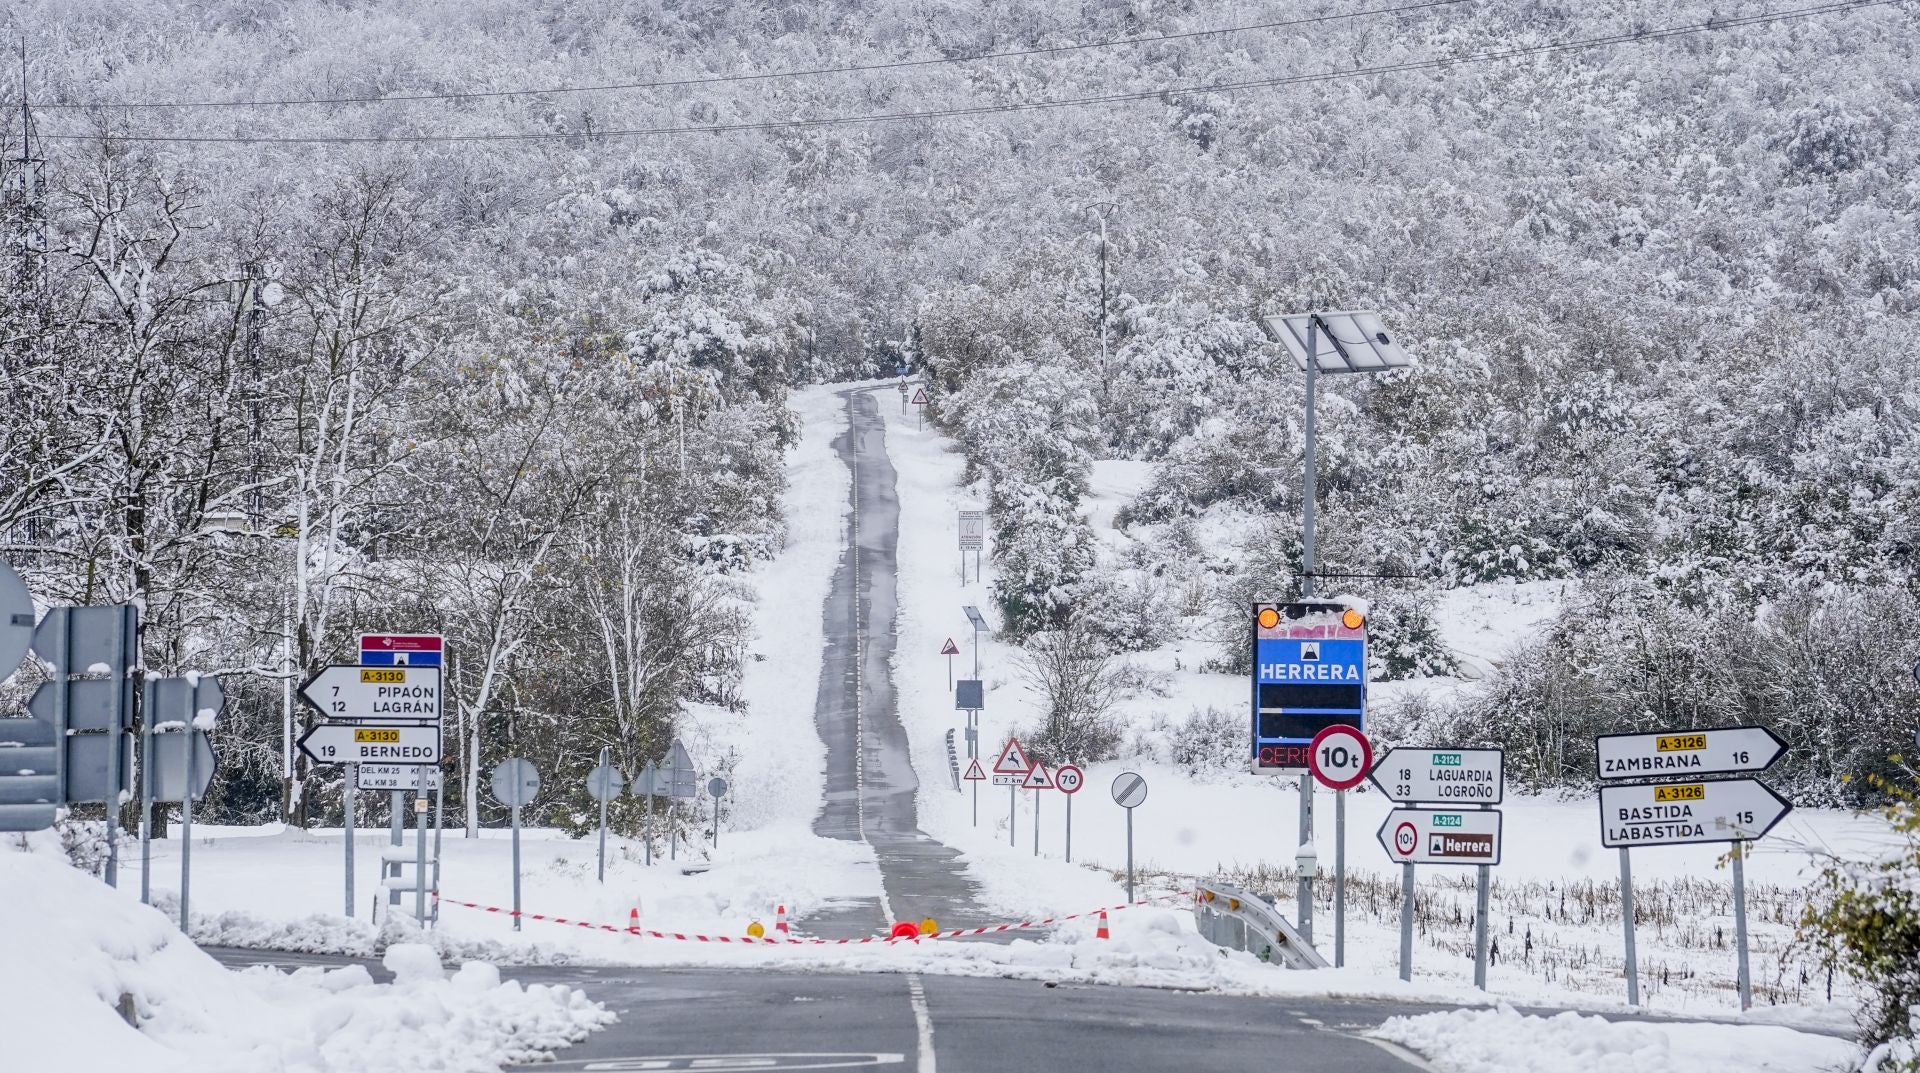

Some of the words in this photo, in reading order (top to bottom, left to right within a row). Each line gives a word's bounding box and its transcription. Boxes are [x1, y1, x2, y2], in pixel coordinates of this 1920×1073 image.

[363, 672, 404, 681] A-3130
[1260, 663, 1360, 680] HERRERA
[332, 686, 340, 697] 7
[378, 685, 434, 698] PIPAÓN
[332, 701, 346, 712] 12
[373, 699, 434, 713] LAGRÁN
[357, 731, 398, 741] A-3130
[1659, 736, 1704, 750] A-3126
[321, 745, 336, 757] 19
[360, 746, 433, 758] BERNEDO
[1433, 755, 1460, 765] A-2124
[1605, 754, 1701, 772] ZAMBRANA
[1732, 751, 1749, 765] 16
[360, 766, 376, 774] DEL
[391, 767, 400, 775] 25
[1399, 768, 1411, 781] 18
[1429, 769, 1493, 782] LAGUARDIA
[1061, 775, 1077, 785] 70
[1396, 784, 1411, 797] 33
[1438, 783, 1493, 798] LOGROÑO
[1657, 786, 1702, 800] A-3126
[1433, 815, 1461, 826] A-2124
[1619, 804, 1693, 821] BASTIDA
[1736, 811, 1754, 824] 15
[1609, 824, 1705, 841] LABASTIDA
[1446, 838, 1491, 852] Herrera
